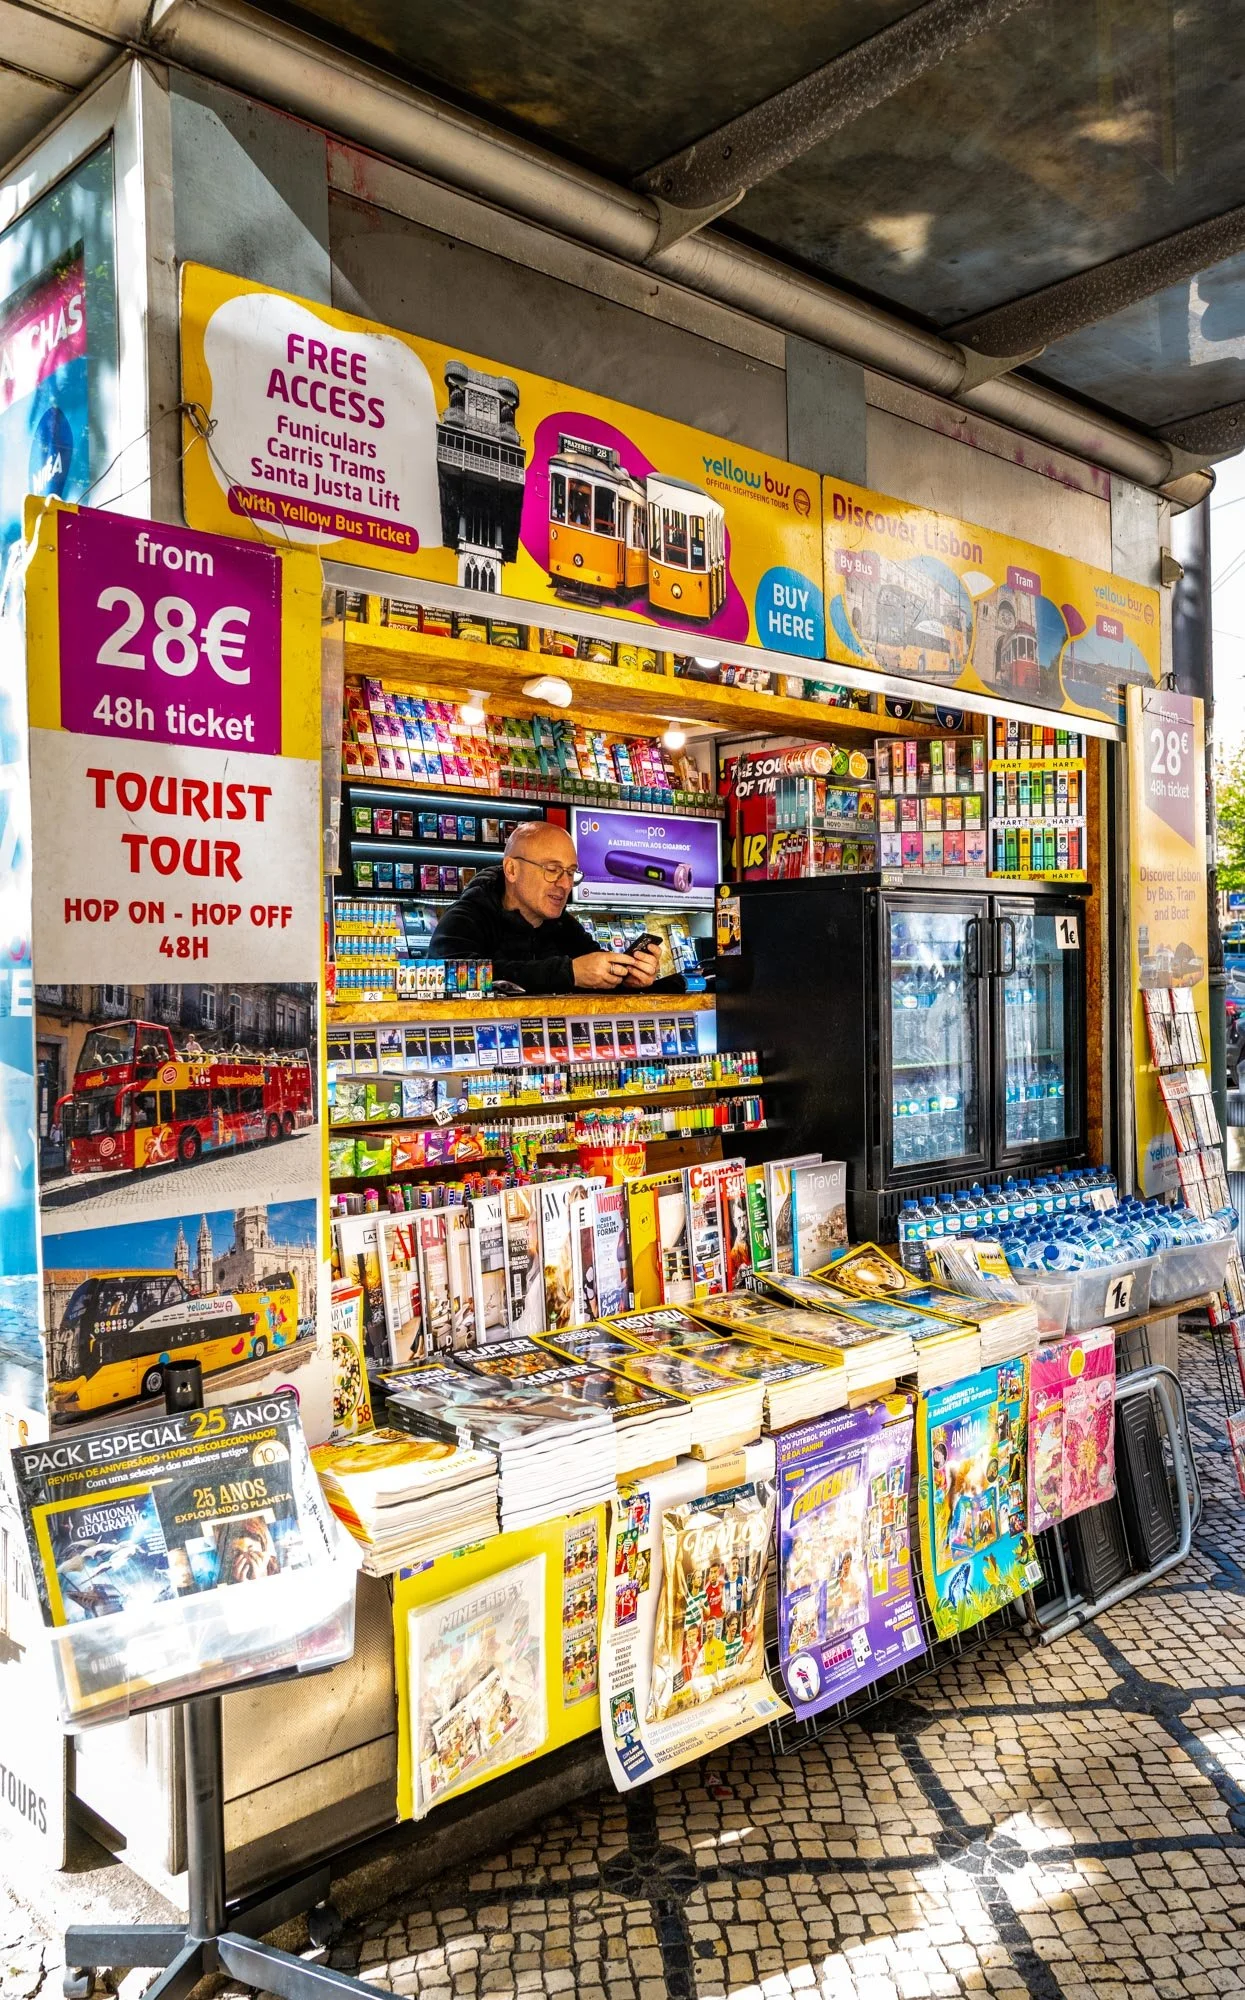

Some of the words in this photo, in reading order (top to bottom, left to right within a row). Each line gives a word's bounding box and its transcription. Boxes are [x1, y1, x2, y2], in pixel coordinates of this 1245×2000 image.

[287, 333, 367, 386] FREE
[266, 369, 385, 429] ACCESS
[277, 415, 377, 458] Funiculars
[563, 438, 592, 452] PRAZERES
[597, 448, 607, 458] 28
[267, 437, 323, 468] Carris
[331, 454, 386, 484] Trams
[251, 458, 308, 489] Santa
[313, 476, 361, 502] Justa
[368, 487, 400, 512] Lift
[705, 478, 732, 493] OFFICIAL
[733, 486, 771, 505] SIGHTSEEING
[771, 498, 789, 511] TOURS
[764, 471, 791, 498] bus
[237, 491, 276, 517] With
[281, 502, 331, 528] Yellow
[335, 514, 364, 536] Bus
[366, 521, 412, 547] Ticket
[833, 493, 917, 543] Discover
[924, 523, 983, 565] Lisbon
[135, 533, 214, 577] from
[840, 555, 853, 572] By
[855, 560, 873, 576] Bus
[1014, 572, 1034, 589] Tram
[773, 583, 810, 613] BUY
[96, 586, 251, 686] 28€
[769, 610, 815, 642] HERE
[1102, 621, 1117, 636] Boat
[93, 694, 155, 731] 48h
[165, 704, 256, 743] ticket
[1159, 706, 1179, 723] from
[86, 768, 273, 823] TOURIST
[735, 780, 755, 798] OF
[1150, 780, 1167, 797] 48h
[1168, 783, 1190, 799] ticket
[580, 818, 600, 836] glo
[647, 826, 666, 839] pro
[121, 833, 243, 883] TOUR
[613, 840, 650, 849] ALTERNATIVA
[1140, 866, 1175, 884] Discover
[1176, 867, 1200, 883] Lisbon
[1146, 886, 1157, 902] by
[1177, 888, 1196, 902] Tram
[64, 898, 119, 924] HOP
[128, 901, 165, 924] ON
[191, 903, 242, 927] HOP
[249, 905, 293, 929] OFF
[1154, 905, 1170, 921] and
[1171, 906, 1189, 921] Boat
[158, 936, 209, 959] 48H
[486, 1097, 498, 1106] 2€
[453, 1338, 536, 1359] SUPER
[553, 1330, 600, 1344] CEREBRO
[399, 1369, 457, 1382] TEORIA
[357, 1405, 372, 1425] 58
[24, 1444, 82, 1475] PACK
[89, 1426, 187, 1461] ESPECIAL
[190, 1408, 227, 1439] 25
[232, 1400, 292, 1429] ANOS
[781, 1443, 791, 1452] DO
[792, 1433, 818, 1450] FUTEBOL
[951, 1420, 981, 1448] ANIMAL
[47, 1471, 85, 1487] REVISTA
[86, 1467, 99, 1478] DE
[99, 1453, 160, 1476] ANIVERSÁRIO
[86, 1479, 107, 1489] Com
[108, 1475, 129, 1485] uma
[166, 1460, 182, 1472] dos
[182, 1453, 220, 1470] melhores
[221, 1447, 249, 1461] artigos
[193, 1489, 213, 1509] 25
[219, 1478, 268, 1504] ANOS
[82, 1503, 140, 1525] NATIONAL
[174, 1504, 239, 1524] EXPLORANDO
[240, 1502, 250, 1512] O
[249, 1492, 293, 1509] PLANETA
[76, 1512, 148, 1539] GEOGRAPHIC
[439, 1579, 525, 1636] MINECRAFT
[654, 1749, 666, 1759] UMA
[0, 1763, 47, 1835] TOURS
